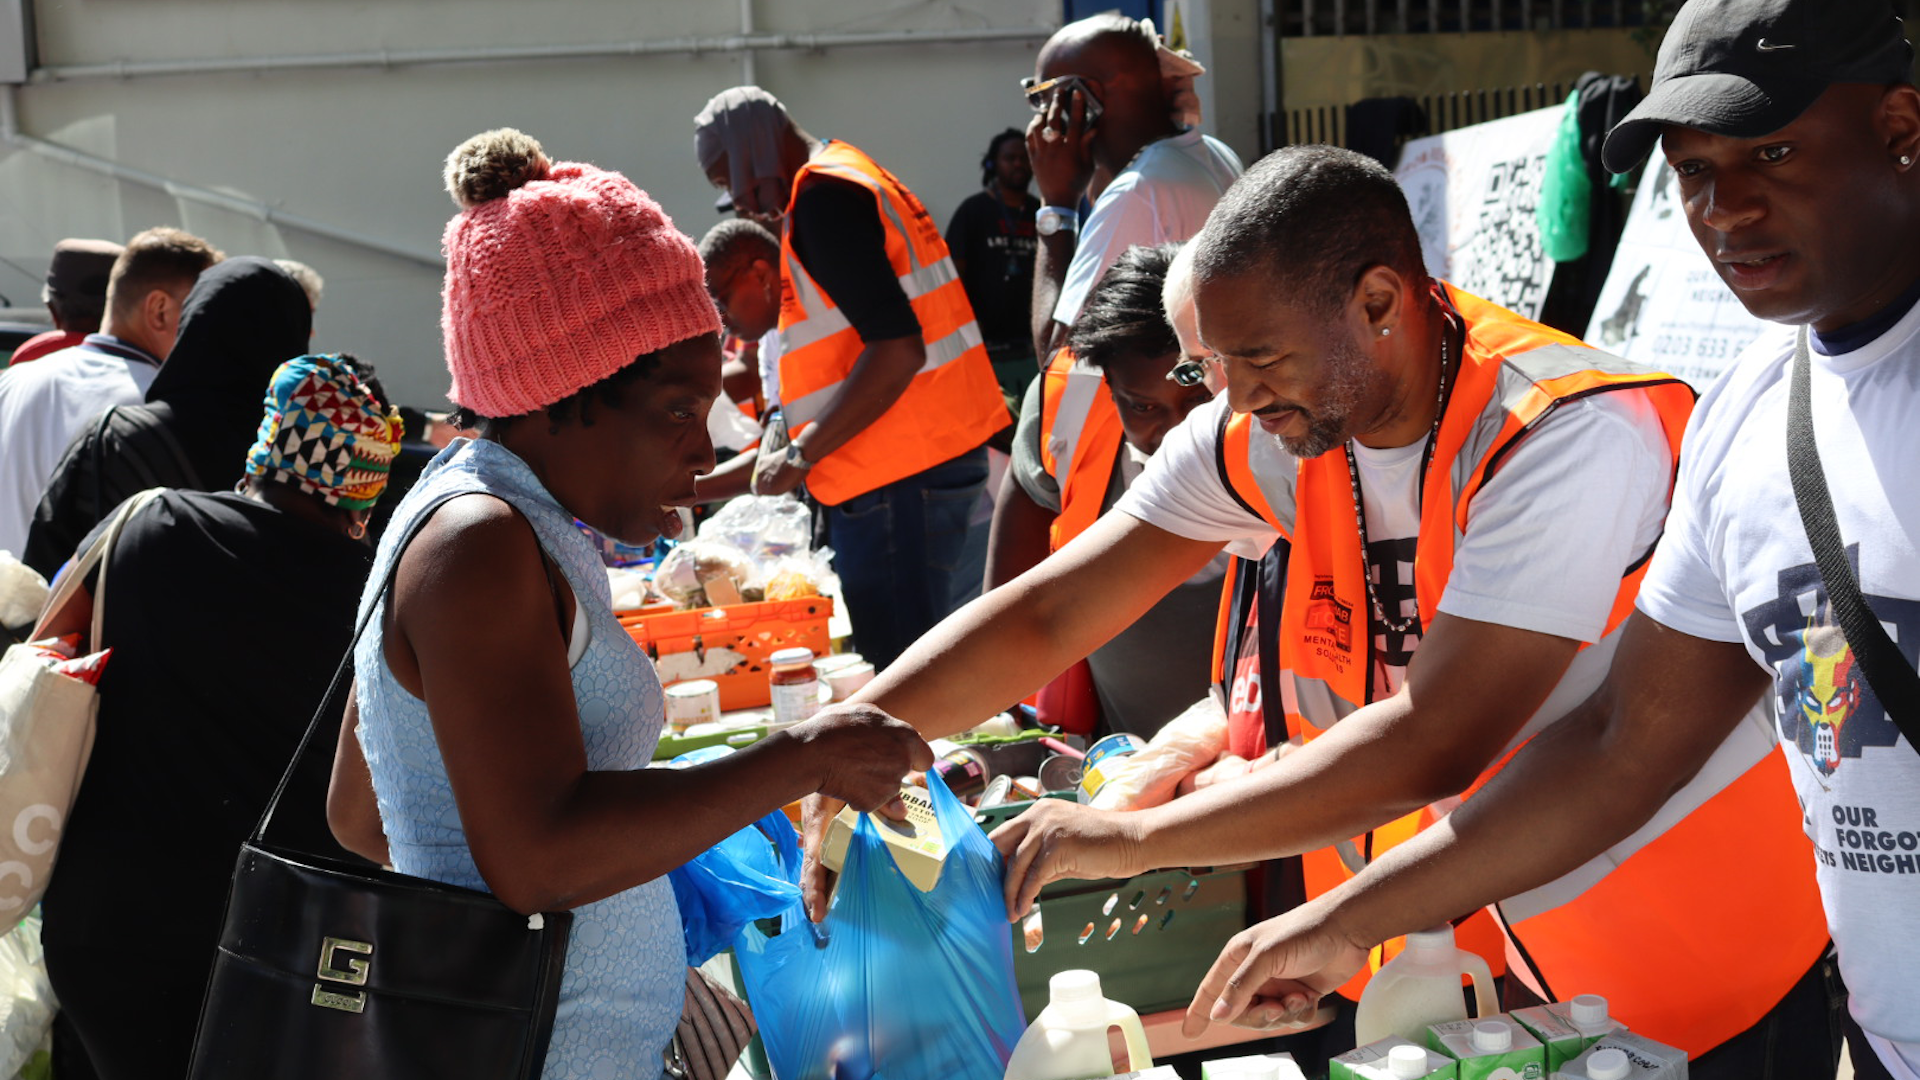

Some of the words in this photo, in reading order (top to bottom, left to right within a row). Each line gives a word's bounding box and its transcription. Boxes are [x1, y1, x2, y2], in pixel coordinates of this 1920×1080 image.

[1697, 338, 1728, 359] 633
[1832, 805, 1879, 828] OUR
[1835, 828, 1920, 851] FORGO
[1840, 851, 1920, 875] NEIGH
